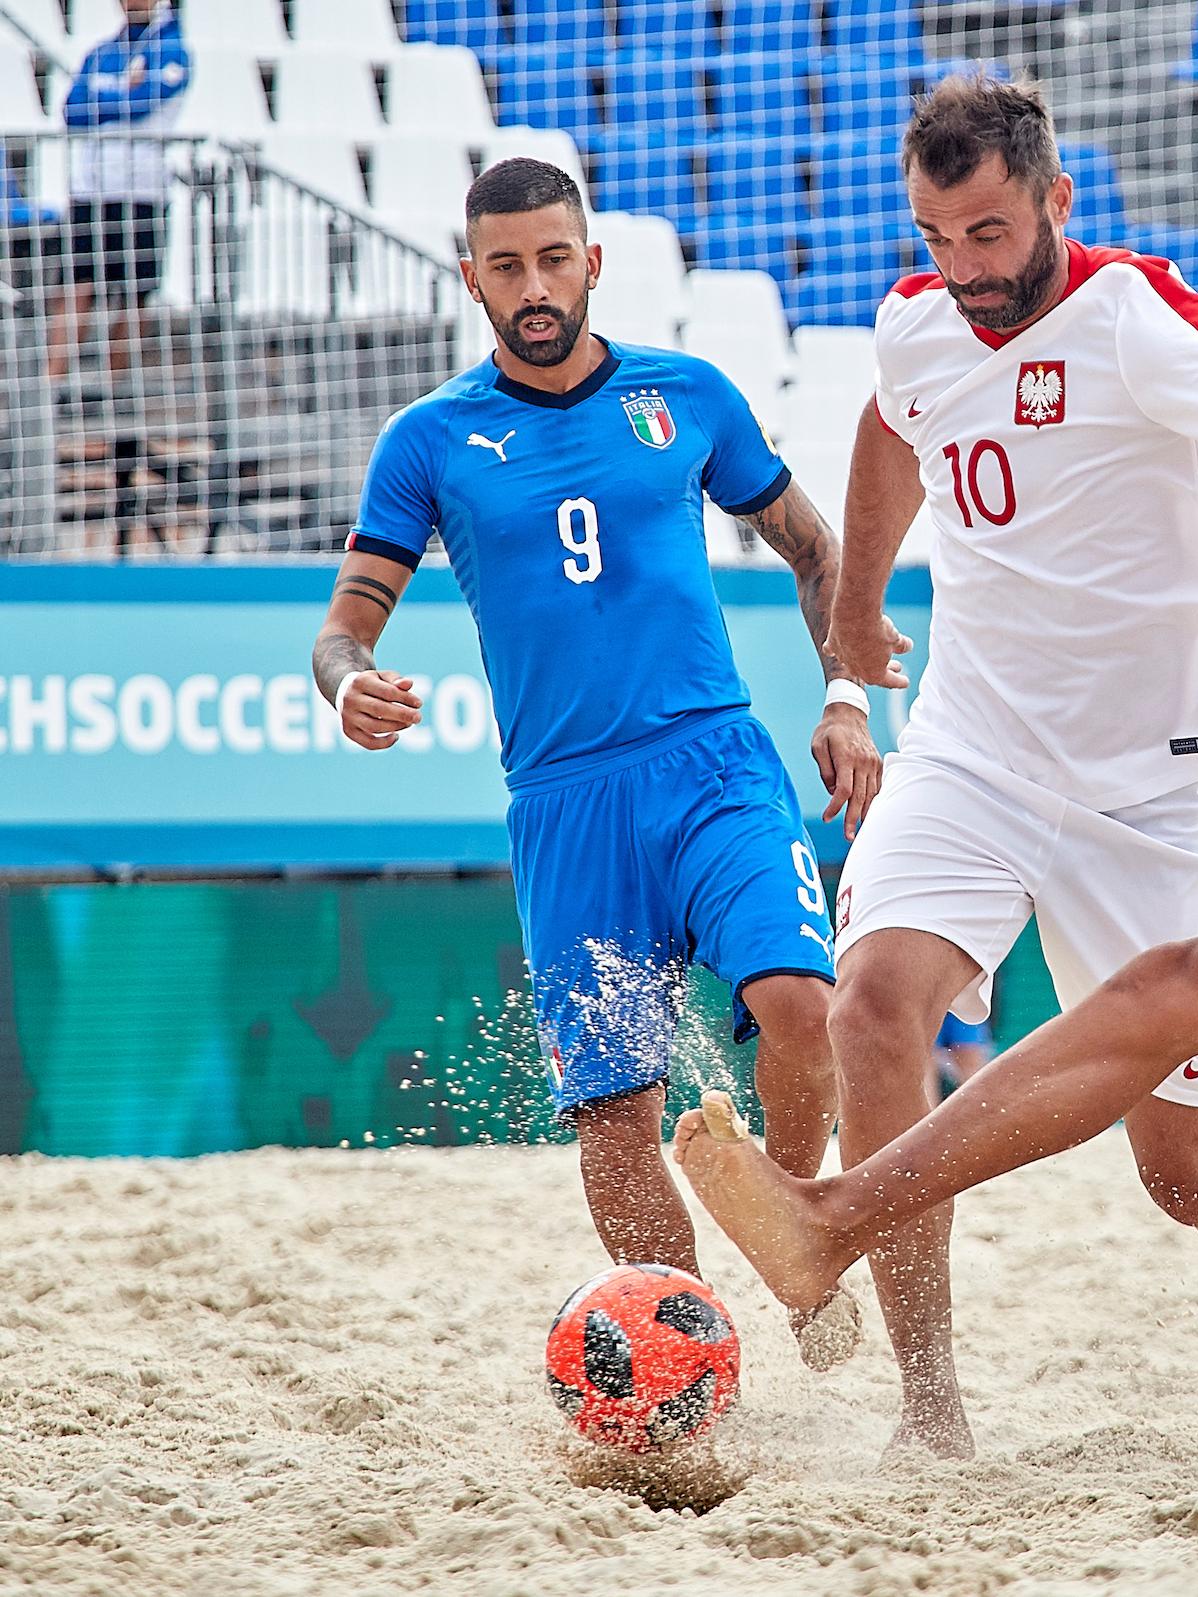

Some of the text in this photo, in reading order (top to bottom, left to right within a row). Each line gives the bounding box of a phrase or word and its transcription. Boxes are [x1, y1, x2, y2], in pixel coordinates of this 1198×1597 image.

[628, 400, 663, 412] ITALIA
[942, 439, 1017, 527] 10
[557, 496, 602, 585] 9
[0, 673, 499, 755] HSOCCECO
[790, 840, 825, 916] 9
